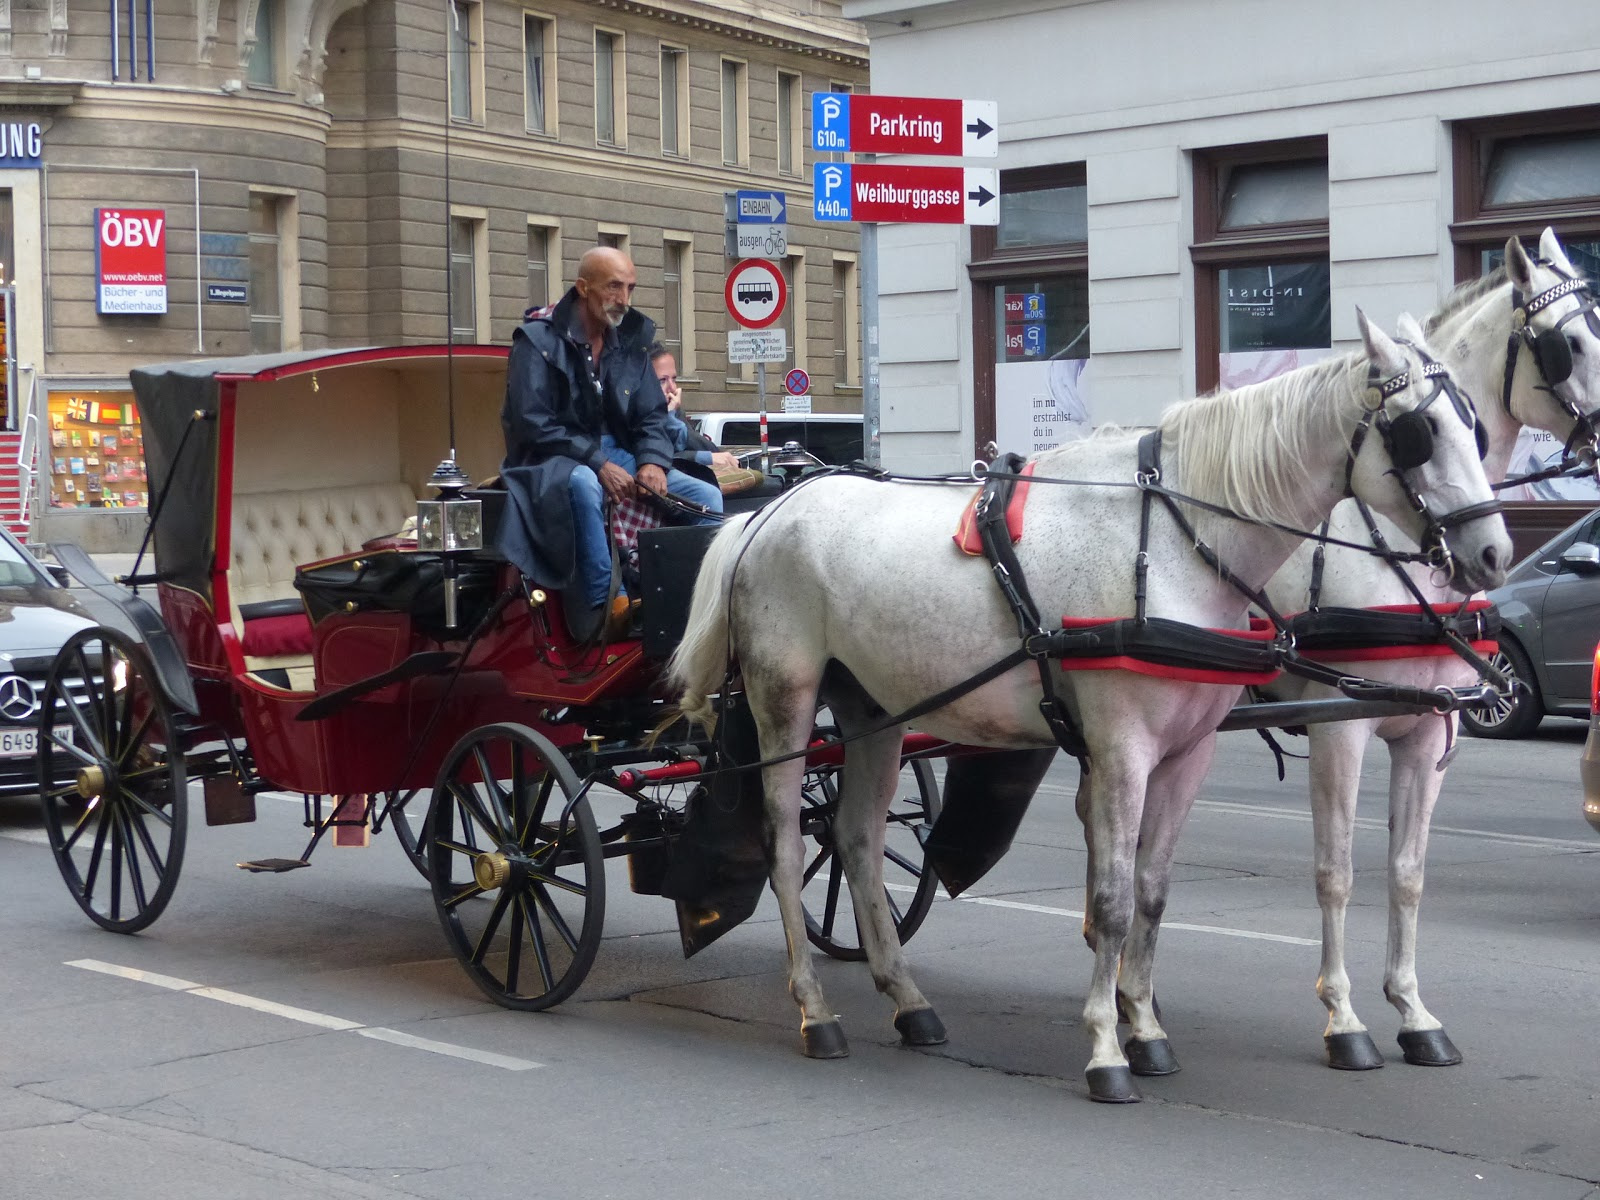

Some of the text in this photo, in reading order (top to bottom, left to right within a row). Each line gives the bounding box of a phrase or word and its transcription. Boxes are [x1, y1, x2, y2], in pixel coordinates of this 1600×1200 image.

[870, 113, 943, 144] Parkring
[817, 130, 845, 147] 610m
[855, 183, 960, 209] Weihburggasse
[742, 200, 771, 214] EINBAHN
[817, 200, 848, 217] 440m
[101, 212, 163, 248] ÖBV
[739, 236, 765, 250] ausgen.
[103, 273, 163, 282] www.oebv.net
[104, 286, 137, 297] Bücher
[145, 288, 163, 297] und
[104, 301, 163, 311] Medienhaus
[1033, 397, 1056, 408] im nu
[1033, 411, 1072, 423] erstrahlst
[1033, 427, 1053, 437] du in
[1533, 430, 1552, 442] wie
